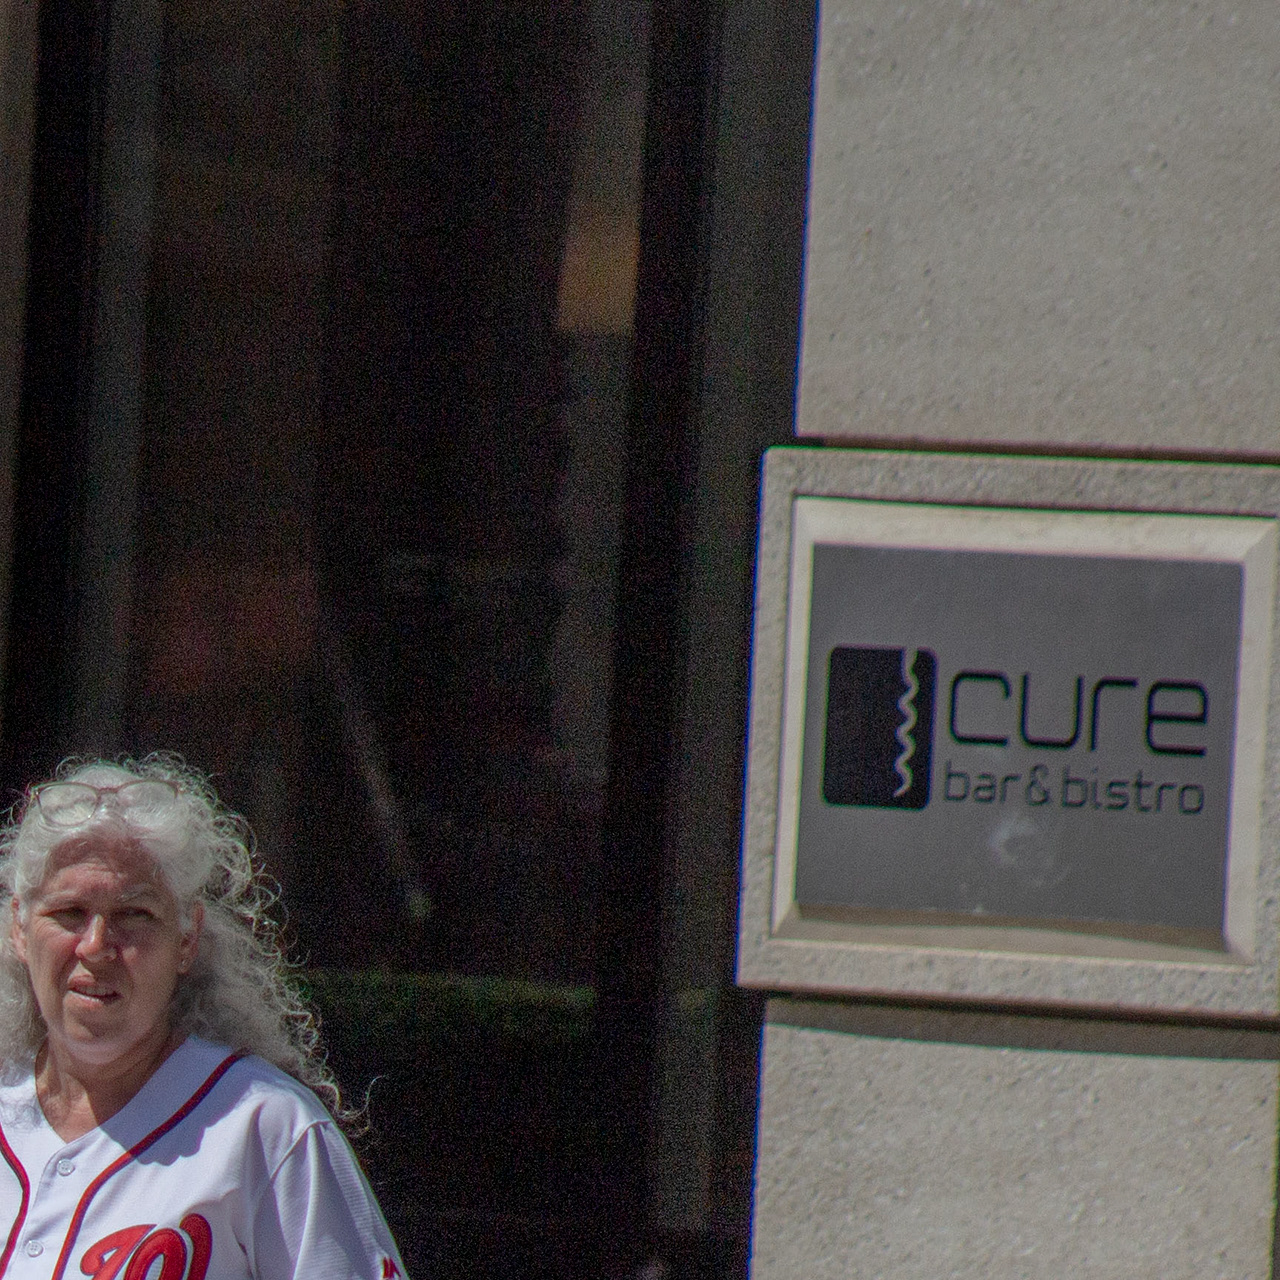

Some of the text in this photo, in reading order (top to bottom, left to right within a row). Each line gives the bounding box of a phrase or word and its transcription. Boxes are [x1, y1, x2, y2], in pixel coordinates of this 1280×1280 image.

[949, 669, 1210, 757] cure
[944, 761, 1021, 801] bar
[1061, 765, 1204, 814] bistro
